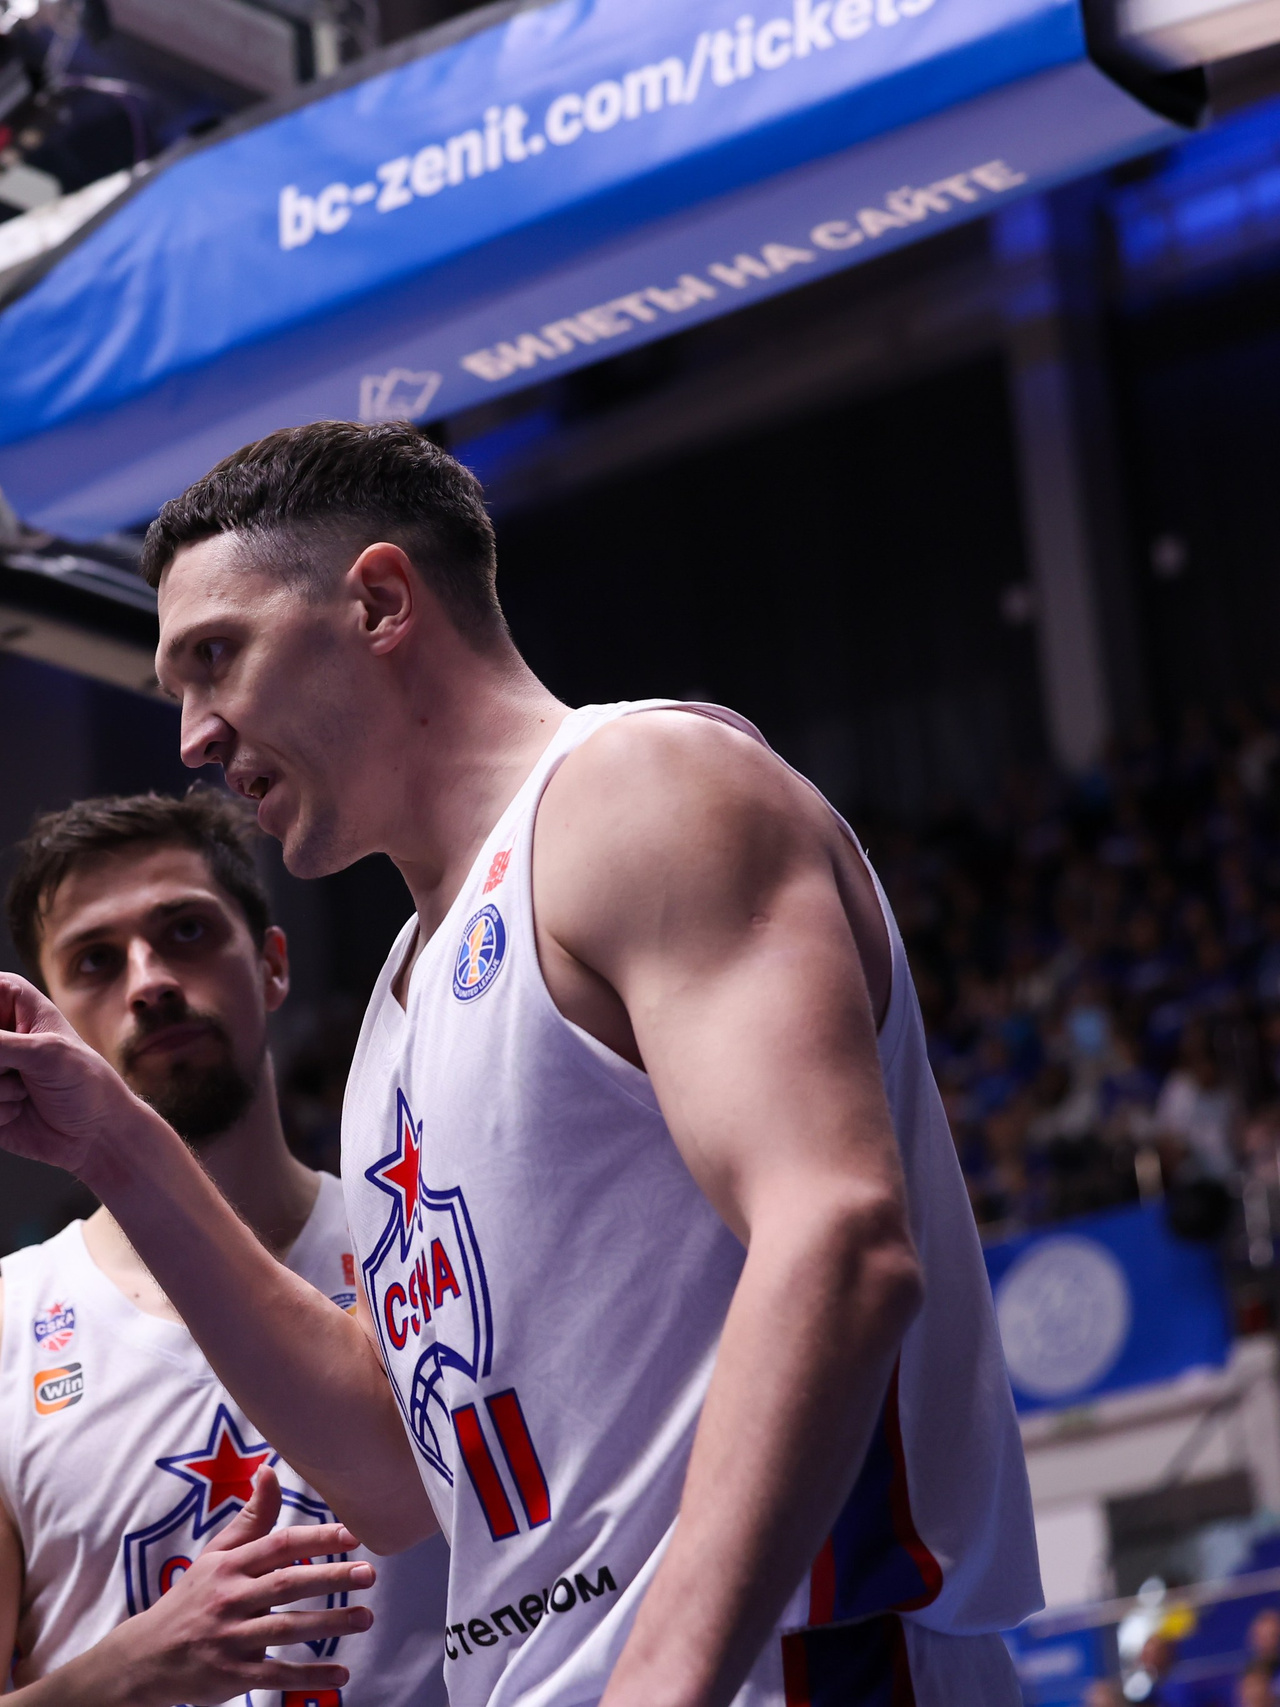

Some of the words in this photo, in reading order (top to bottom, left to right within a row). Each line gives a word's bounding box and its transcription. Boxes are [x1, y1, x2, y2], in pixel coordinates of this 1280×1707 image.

[460, 273, 718, 382] БИЛЕТЫ
[708, 242, 816, 289] НА
[809, 158, 1028, 251] САЙТЕ
[477, 958, 501, 990] LEAGUE
[35, 1311, 75, 1336] CSKA
[43, 1377, 83, 1400] Win
